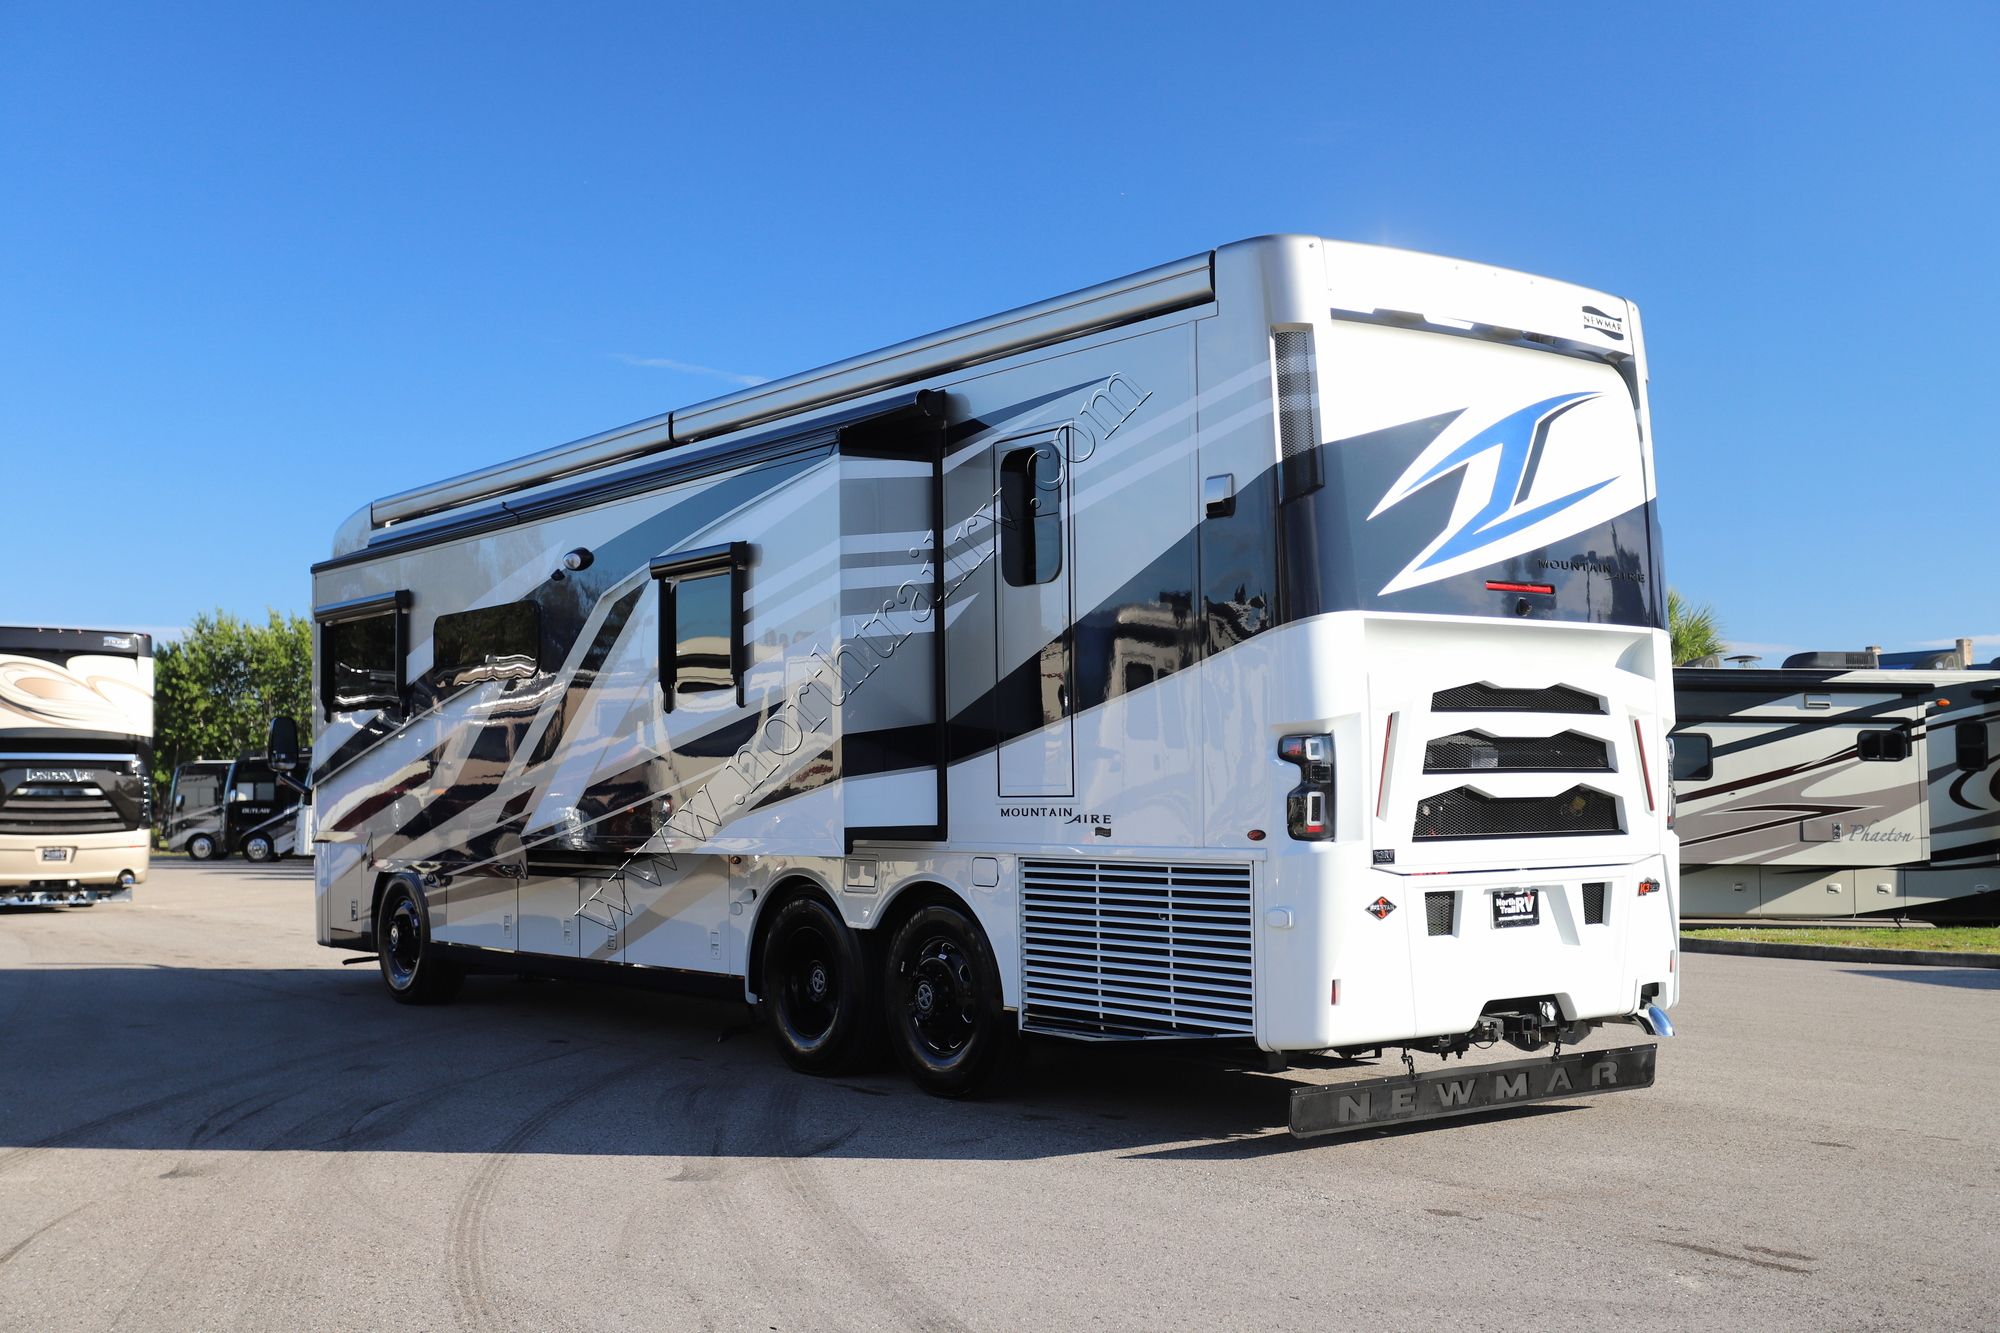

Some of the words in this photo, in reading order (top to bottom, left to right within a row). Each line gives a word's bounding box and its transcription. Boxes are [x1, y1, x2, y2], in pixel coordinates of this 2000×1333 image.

[1583, 315, 1622, 332] NEWMAR
[1538, 559, 1612, 573] MOUNTAIN
[1604, 570, 1645, 583] AIRE
[1000, 807, 1073, 817] MOUNTAIN
[1064, 814, 1112, 825] AIRE
[1848, 819, 1914, 842] Phaeton
[1496, 898, 1516, 907] North
[1515, 895, 1534, 913] RV
[1500, 905, 1516, 914] Trail
[1338, 1061, 1619, 1122] NEWMAR
